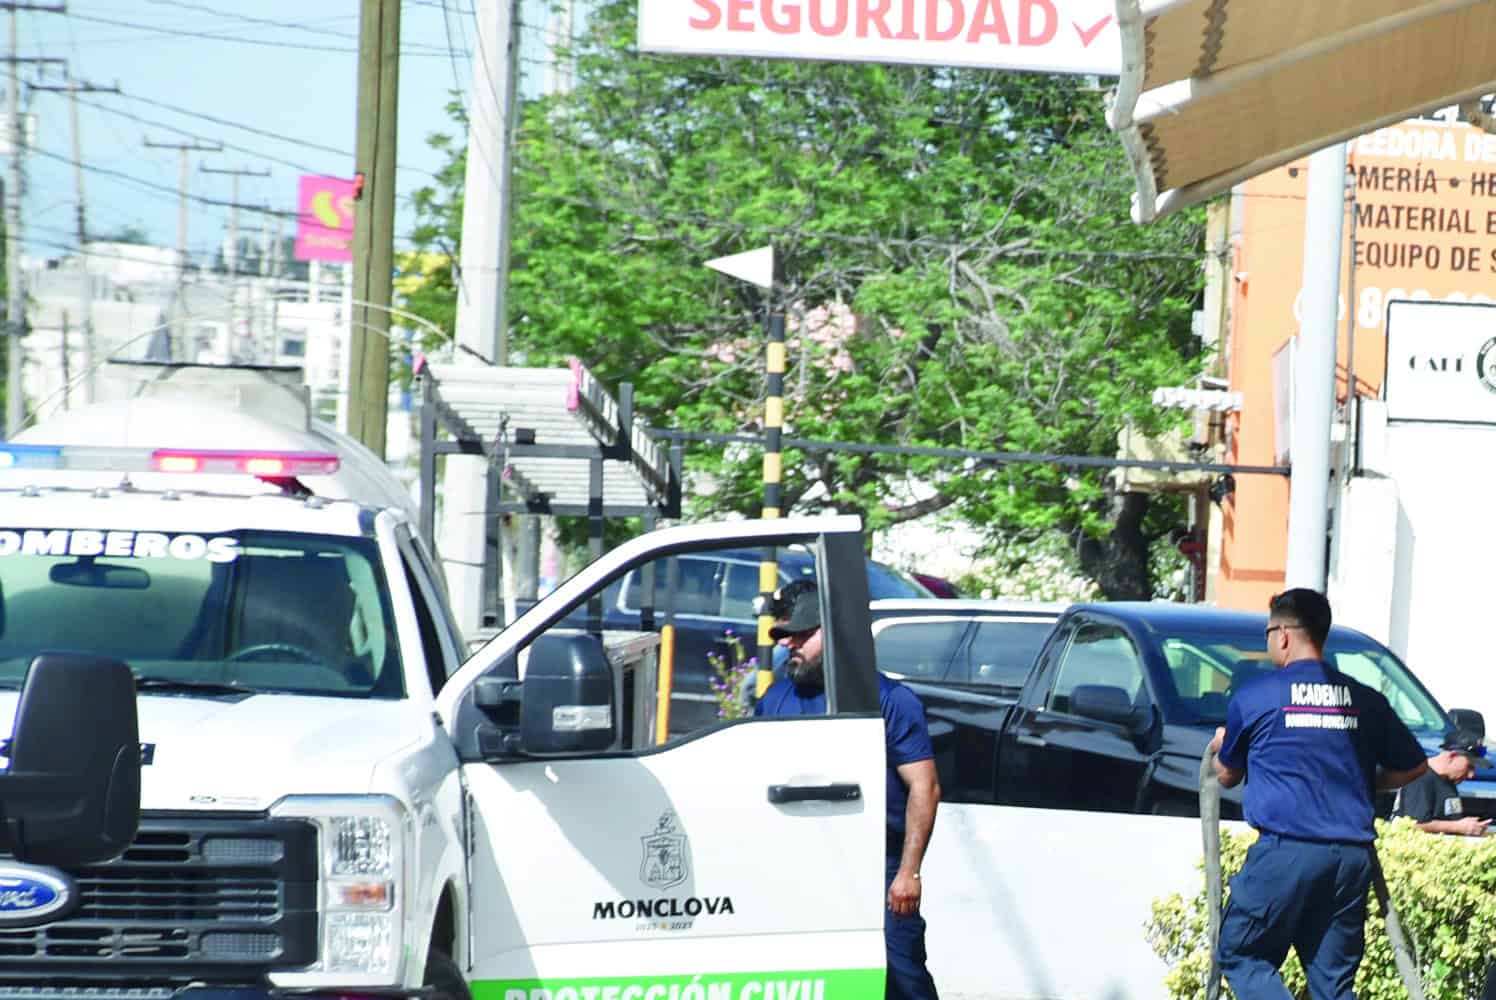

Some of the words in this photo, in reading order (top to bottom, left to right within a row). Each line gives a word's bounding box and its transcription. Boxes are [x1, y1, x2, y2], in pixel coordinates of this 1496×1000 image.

[688, 0, 1058, 46] SEGURIDAD
[1465, 133, 1496, 163] DE
[1355, 202, 1476, 234] MATERIAL
[1354, 241, 1440, 270] EQUIPO
[1450, 246, 1481, 272] DE
[0, 530, 240, 563] OMBEROS
[1290, 683, 1353, 707] ACADEMIA
[592, 895, 736, 920] MONCLOVA
